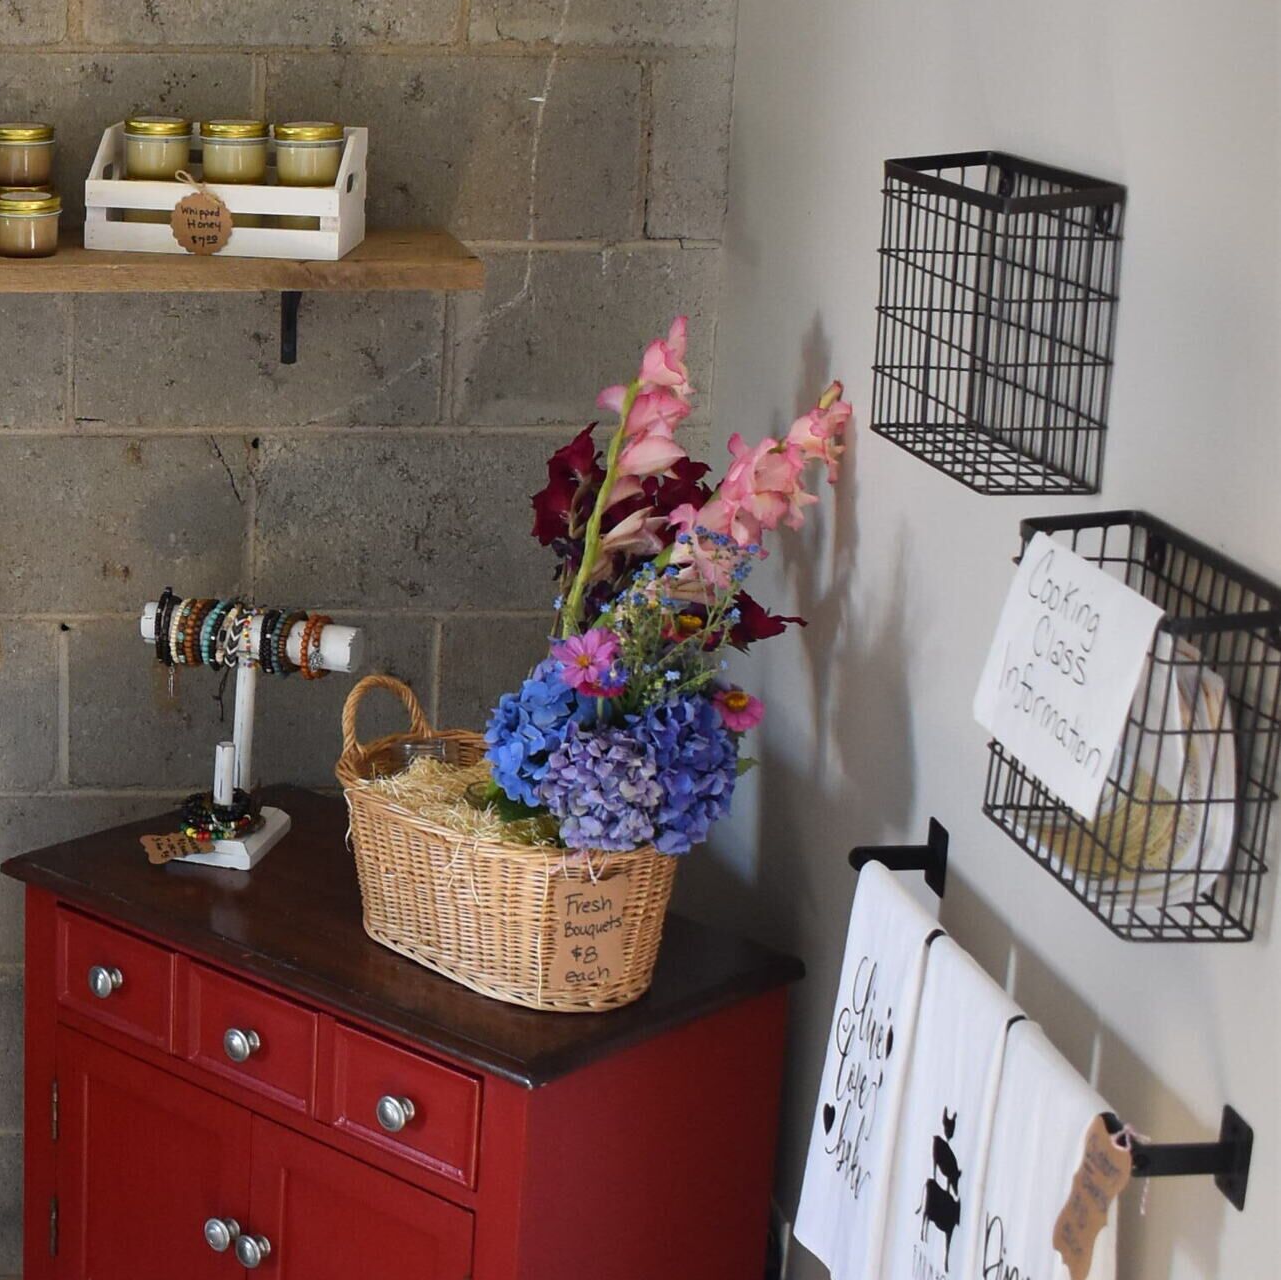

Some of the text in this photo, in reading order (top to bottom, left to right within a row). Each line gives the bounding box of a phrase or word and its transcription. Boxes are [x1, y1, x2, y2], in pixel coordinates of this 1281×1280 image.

[180, 204, 221, 221] Whipped
[187, 218, 222, 232] Honey
[1027, 548, 1101, 654] Cooking
[1032, 614, 1087, 686] Class
[998, 640, 1103, 778] Information
[564, 892, 613, 916] Fresh
[563, 915, 623, 940] Bouquets
[571, 945, 599, 964] $8
[565, 966, 610, 983] each
